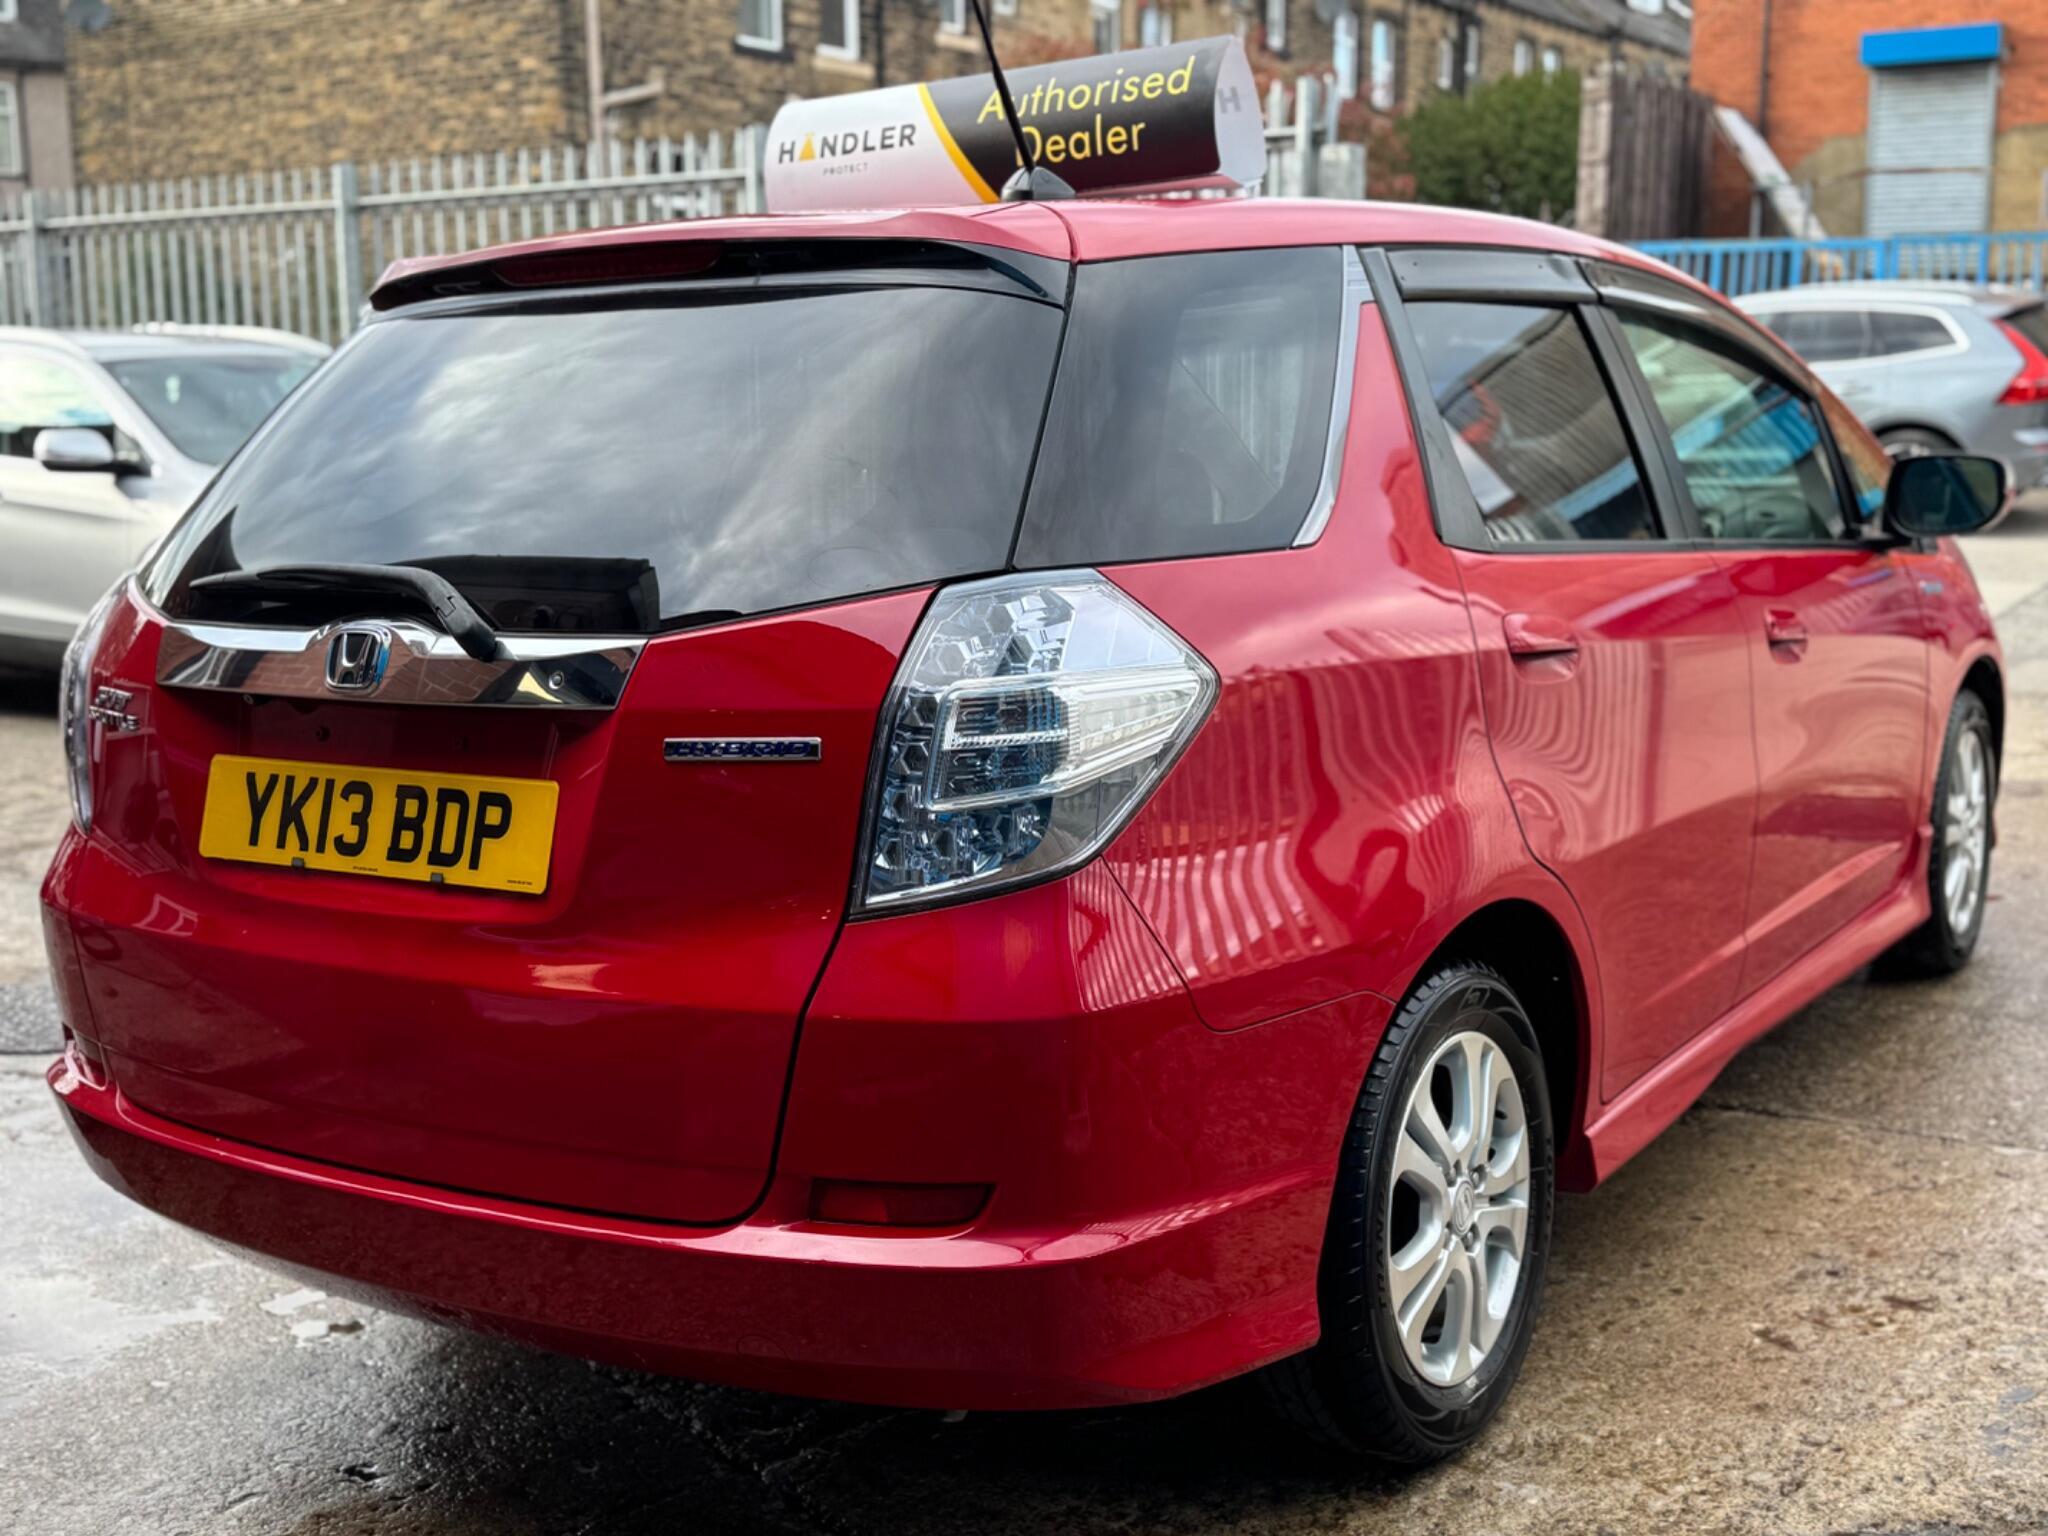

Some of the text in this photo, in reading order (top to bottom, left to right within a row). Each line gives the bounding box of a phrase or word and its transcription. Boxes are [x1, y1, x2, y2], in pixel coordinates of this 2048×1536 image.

[976, 55, 1197, 125] Authorised
[823, 163, 869, 176] PROTECT
[1015, 113, 1146, 167] Dealer
[245, 770, 513, 871] YK13 BDP
